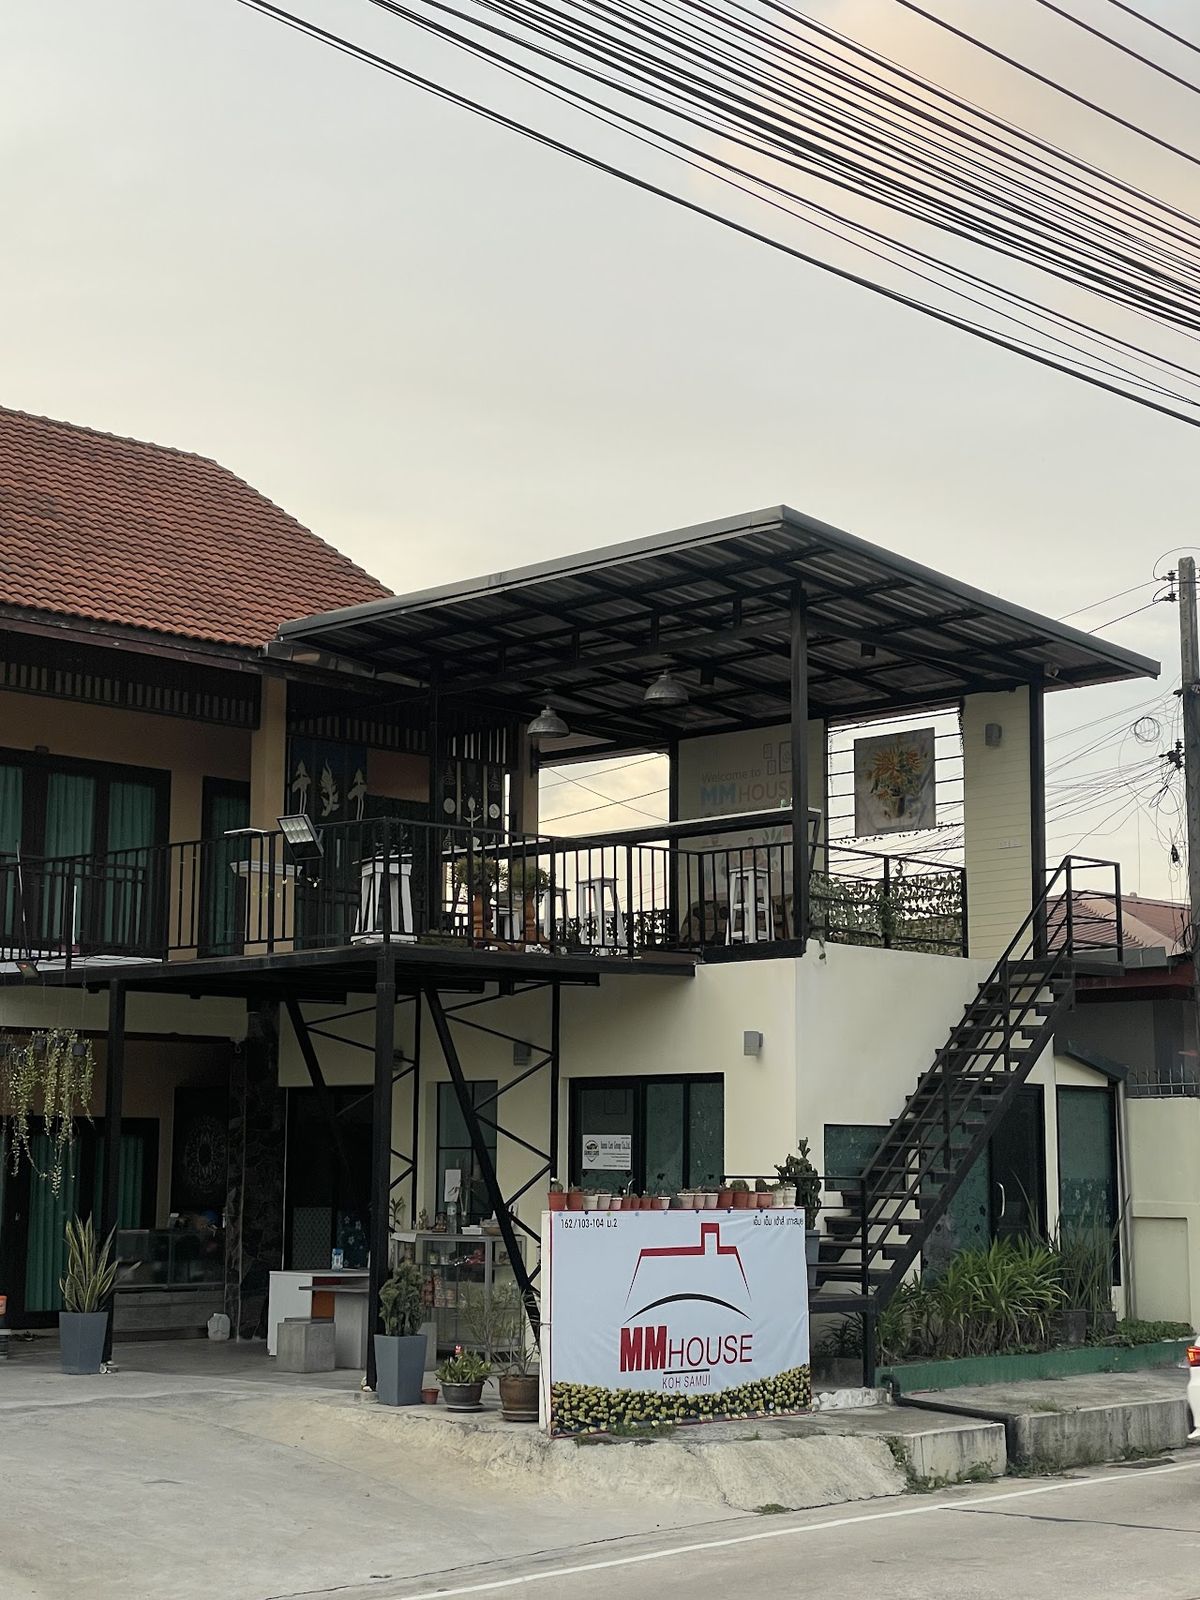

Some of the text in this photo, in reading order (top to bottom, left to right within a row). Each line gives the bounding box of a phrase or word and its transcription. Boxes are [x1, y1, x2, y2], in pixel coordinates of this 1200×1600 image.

[702, 768, 761, 783] Welcome to
[739, 780, 788, 804] HOUS
[560, 1218, 604, 1229] 162/103-104
[662, 1374, 711, 1389] KOH SAMUI
